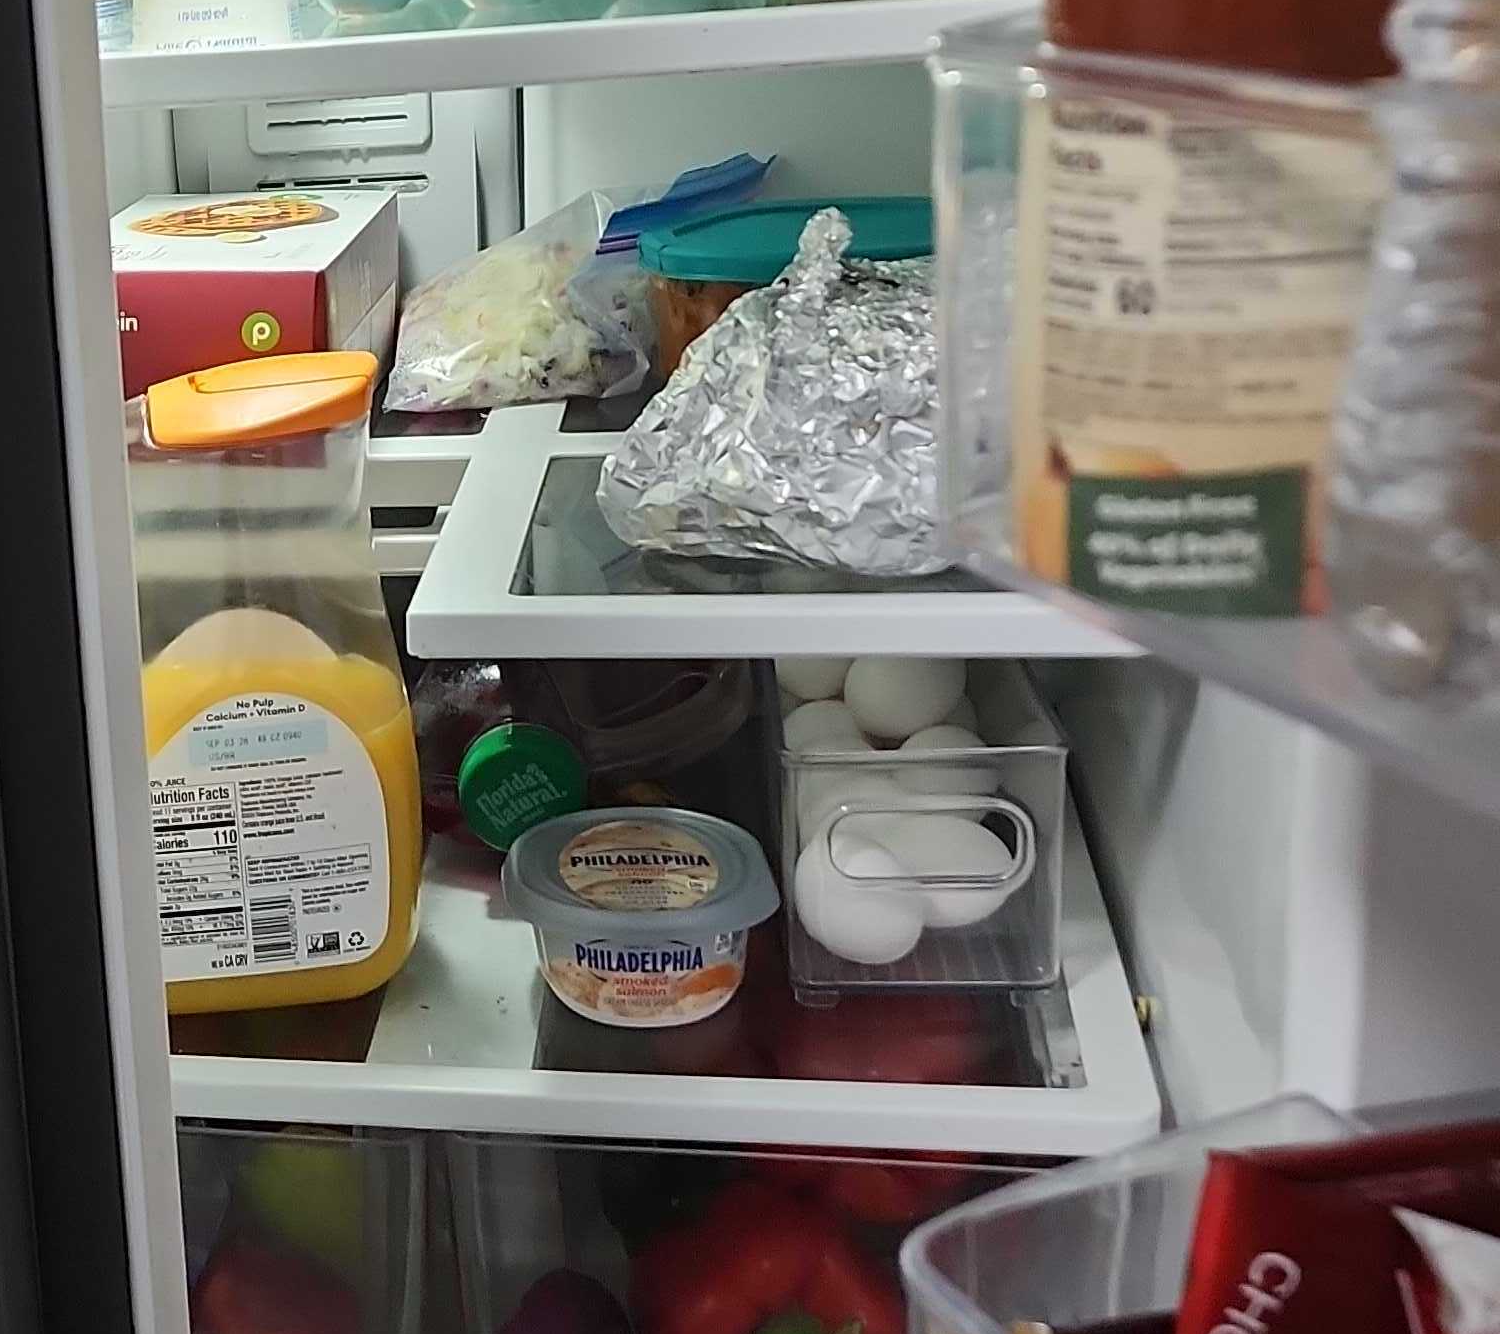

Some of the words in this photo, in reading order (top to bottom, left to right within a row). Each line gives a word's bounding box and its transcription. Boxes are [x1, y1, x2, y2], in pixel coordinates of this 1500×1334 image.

[205, 710, 248, 722] Calcium
[255, 705, 297, 717] Vitamin
[298, 703, 306, 712] D
[235, 700, 250, 710] No
[252, 698, 274, 709] Pulp
[150, 789, 196, 806] utrition
[199, 786, 230, 801] Facts
[156, 836, 189, 851] alories
[213, 828, 238, 846] 110
[569, 853, 711, 868] PHILADELPHIA
[575, 942, 704, 974] PHILADELPHIA
[612, 974, 669, 986] smoked
[615, 986, 668, 997] salmon
